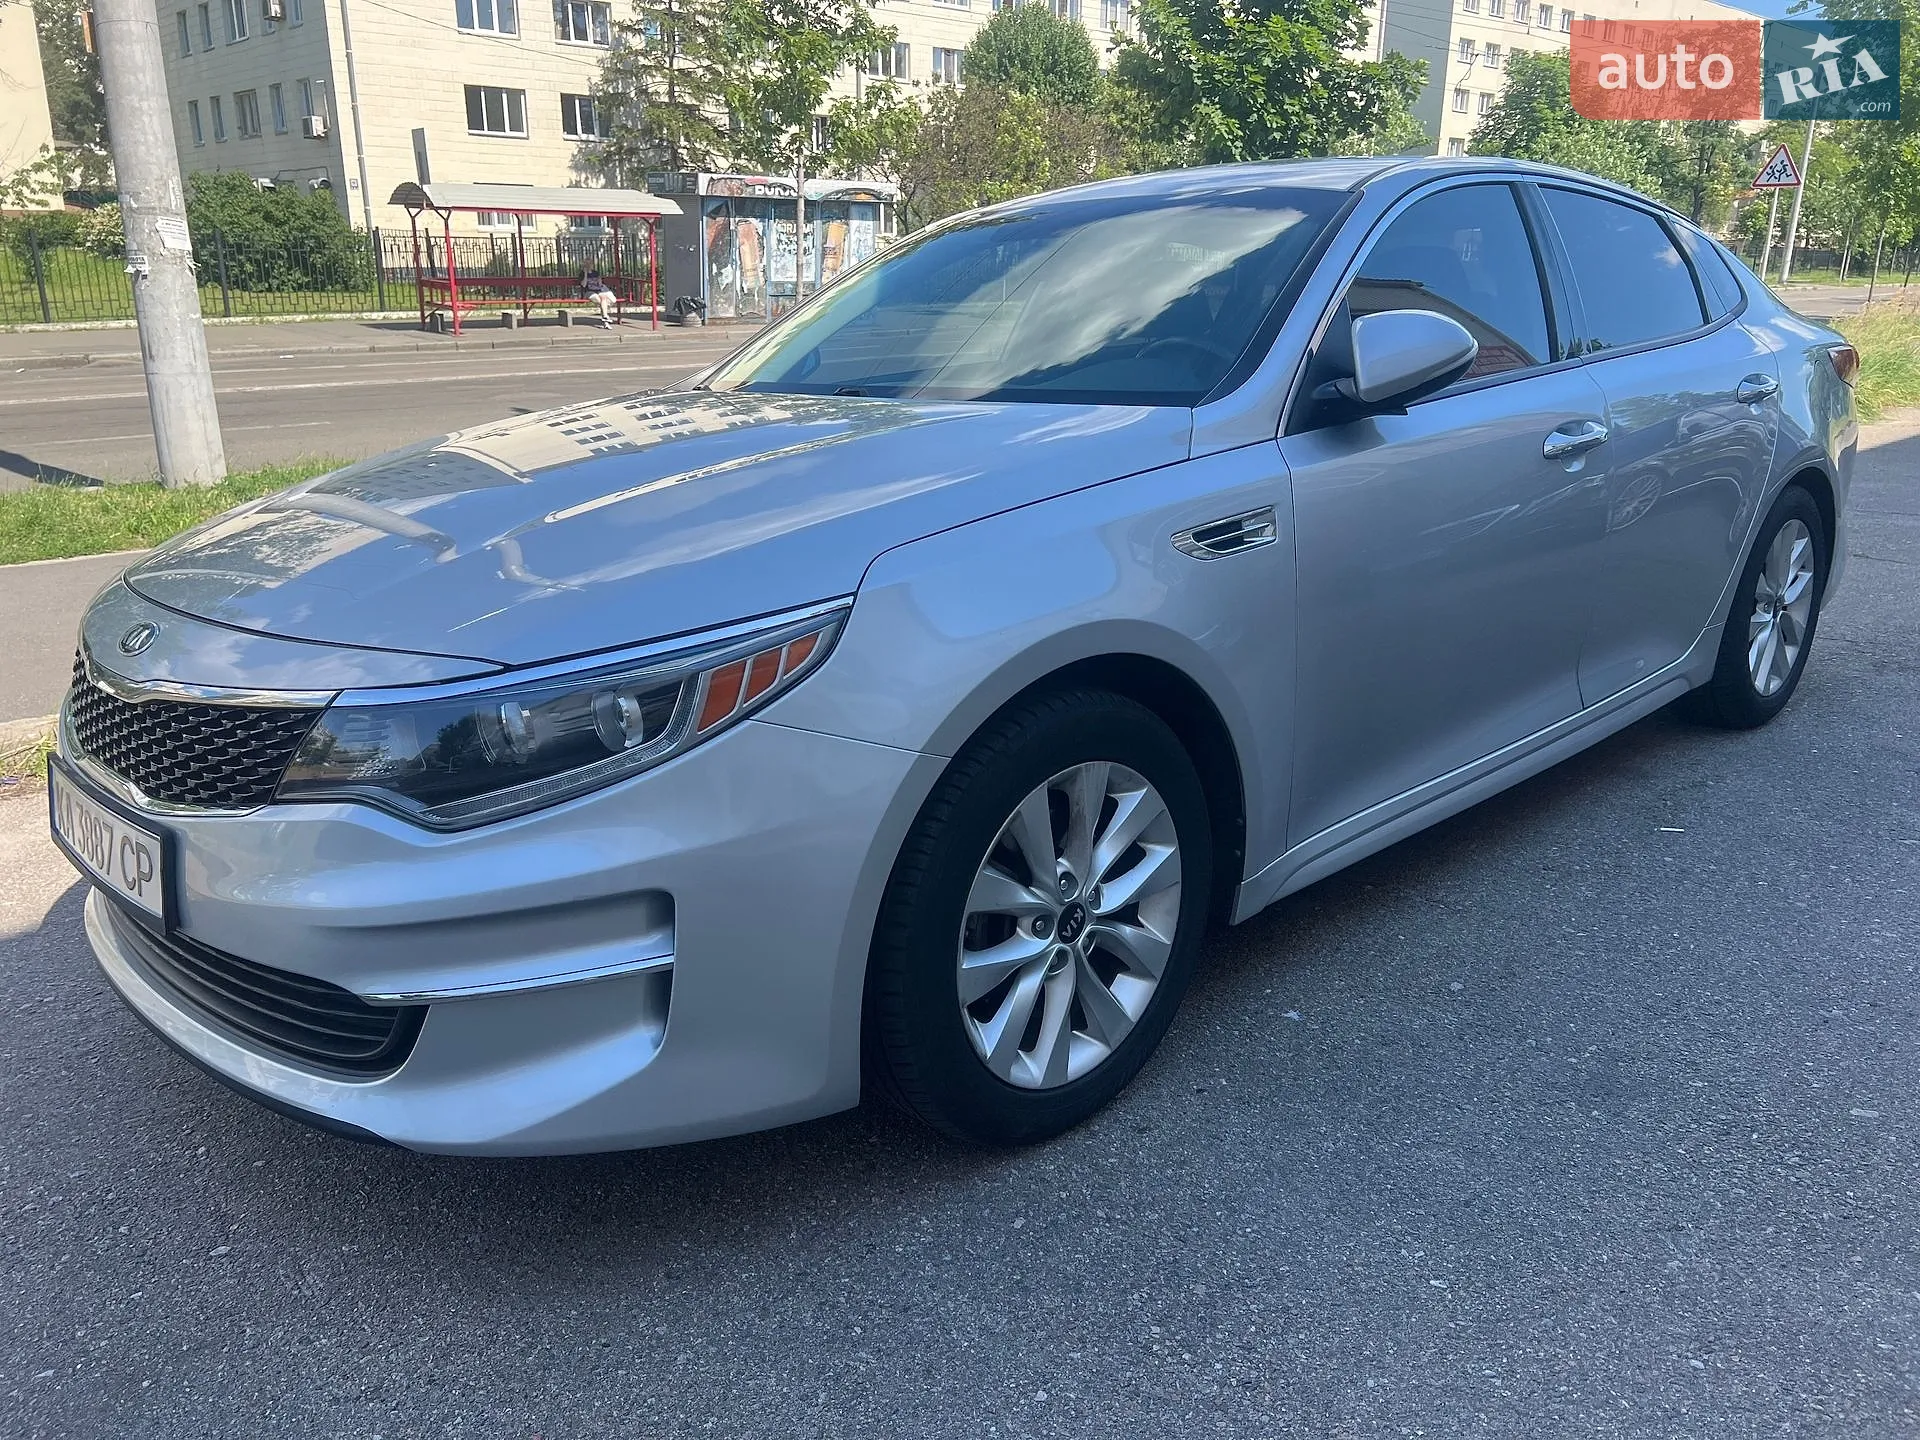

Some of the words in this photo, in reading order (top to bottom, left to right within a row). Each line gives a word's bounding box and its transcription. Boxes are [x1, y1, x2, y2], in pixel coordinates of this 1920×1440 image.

[56, 781, 76, 846] KA
[75, 803, 114, 876] 3887
[120, 834, 153, 897] CP
[1062, 907, 1084, 937] KIA
